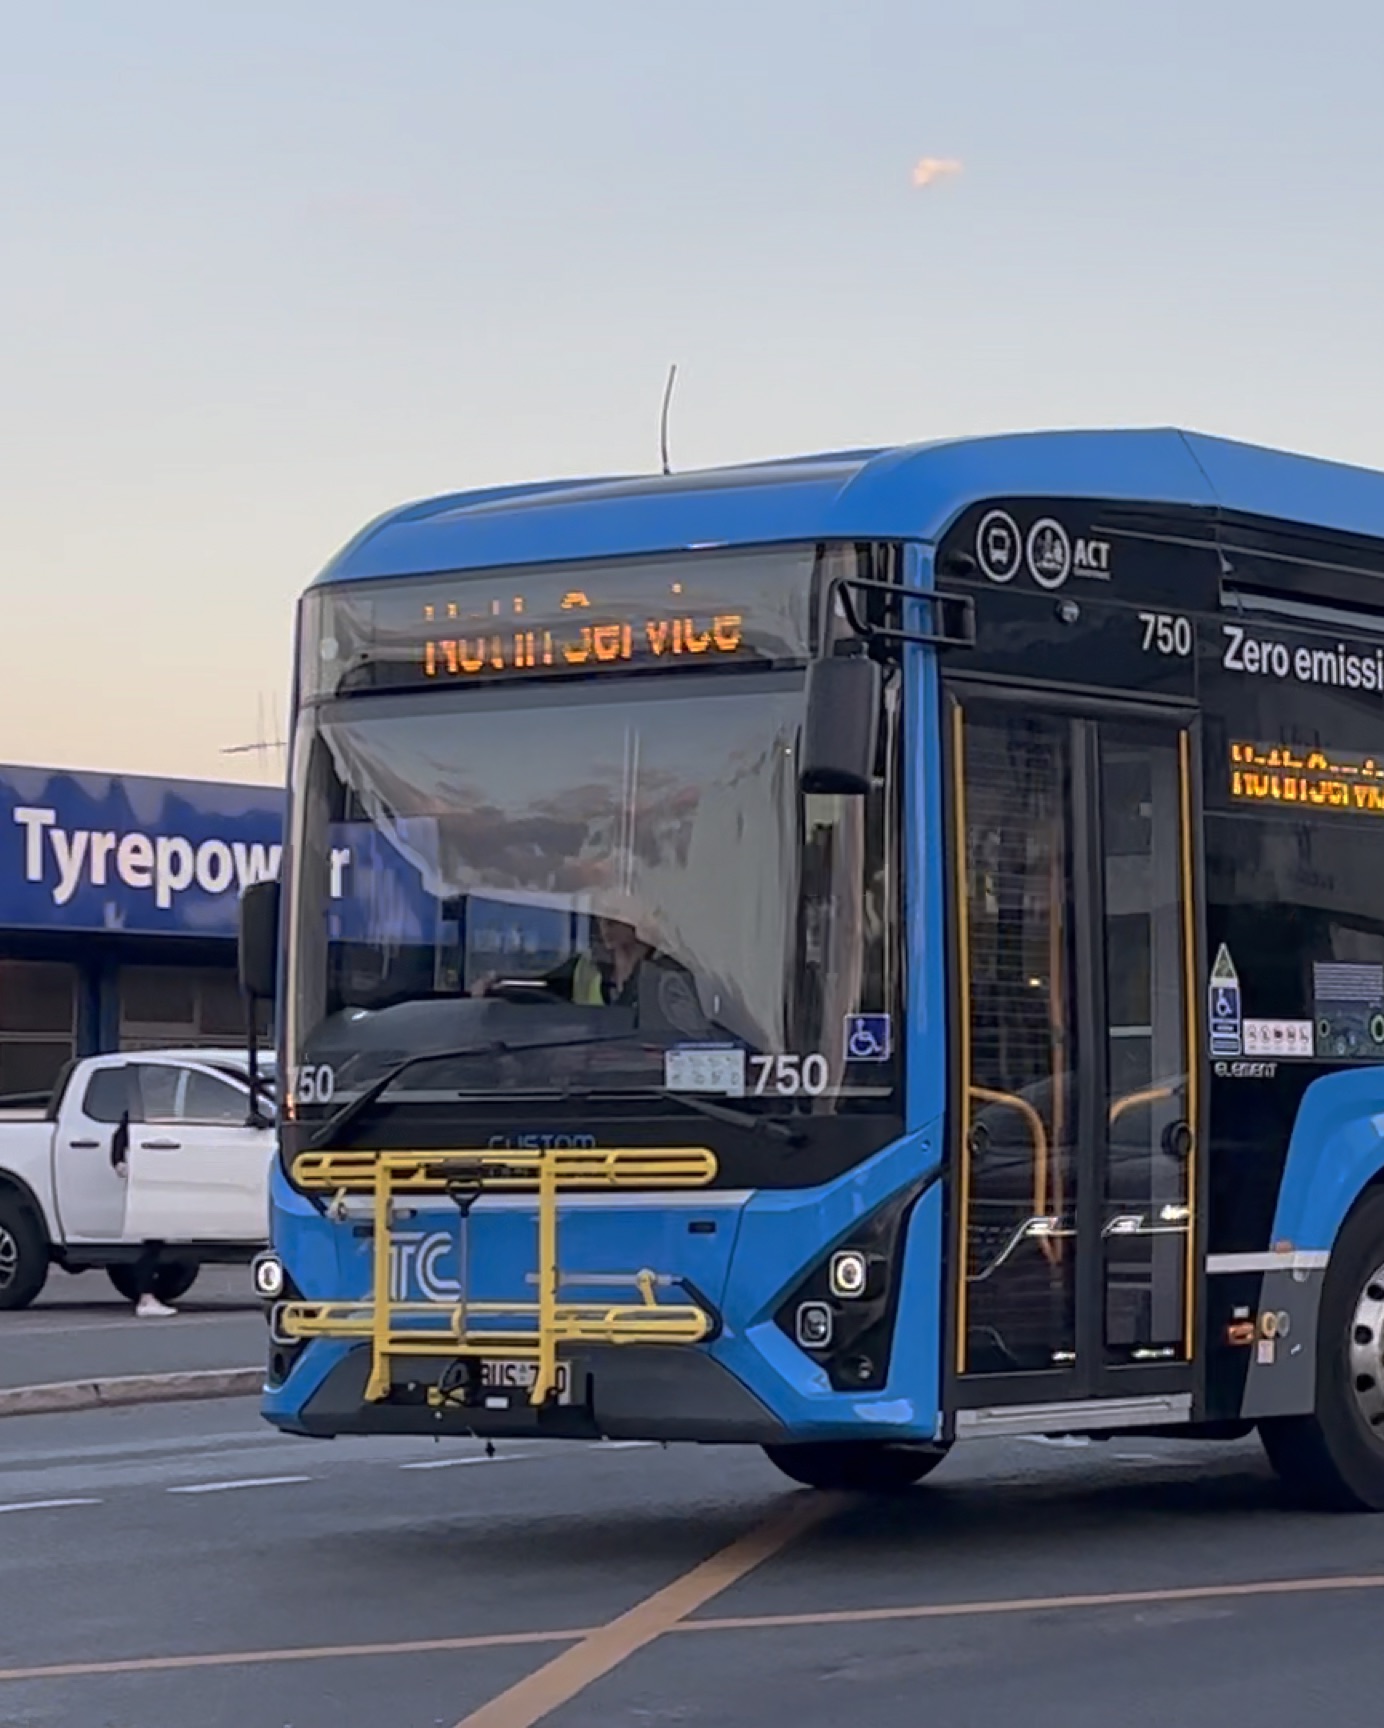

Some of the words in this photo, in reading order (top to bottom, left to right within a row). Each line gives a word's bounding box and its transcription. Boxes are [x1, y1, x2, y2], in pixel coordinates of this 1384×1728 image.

[1074, 538, 1110, 569] ACT
[1138, 611, 1192, 656] 750
[1222, 625, 1289, 677] Zero
[13, 806, 350, 909] Tyrepowr
[750, 1054, 829, 1096] 750
[389, 1231, 462, 1302] TC
[528, 1364, 567, 1395] 70
